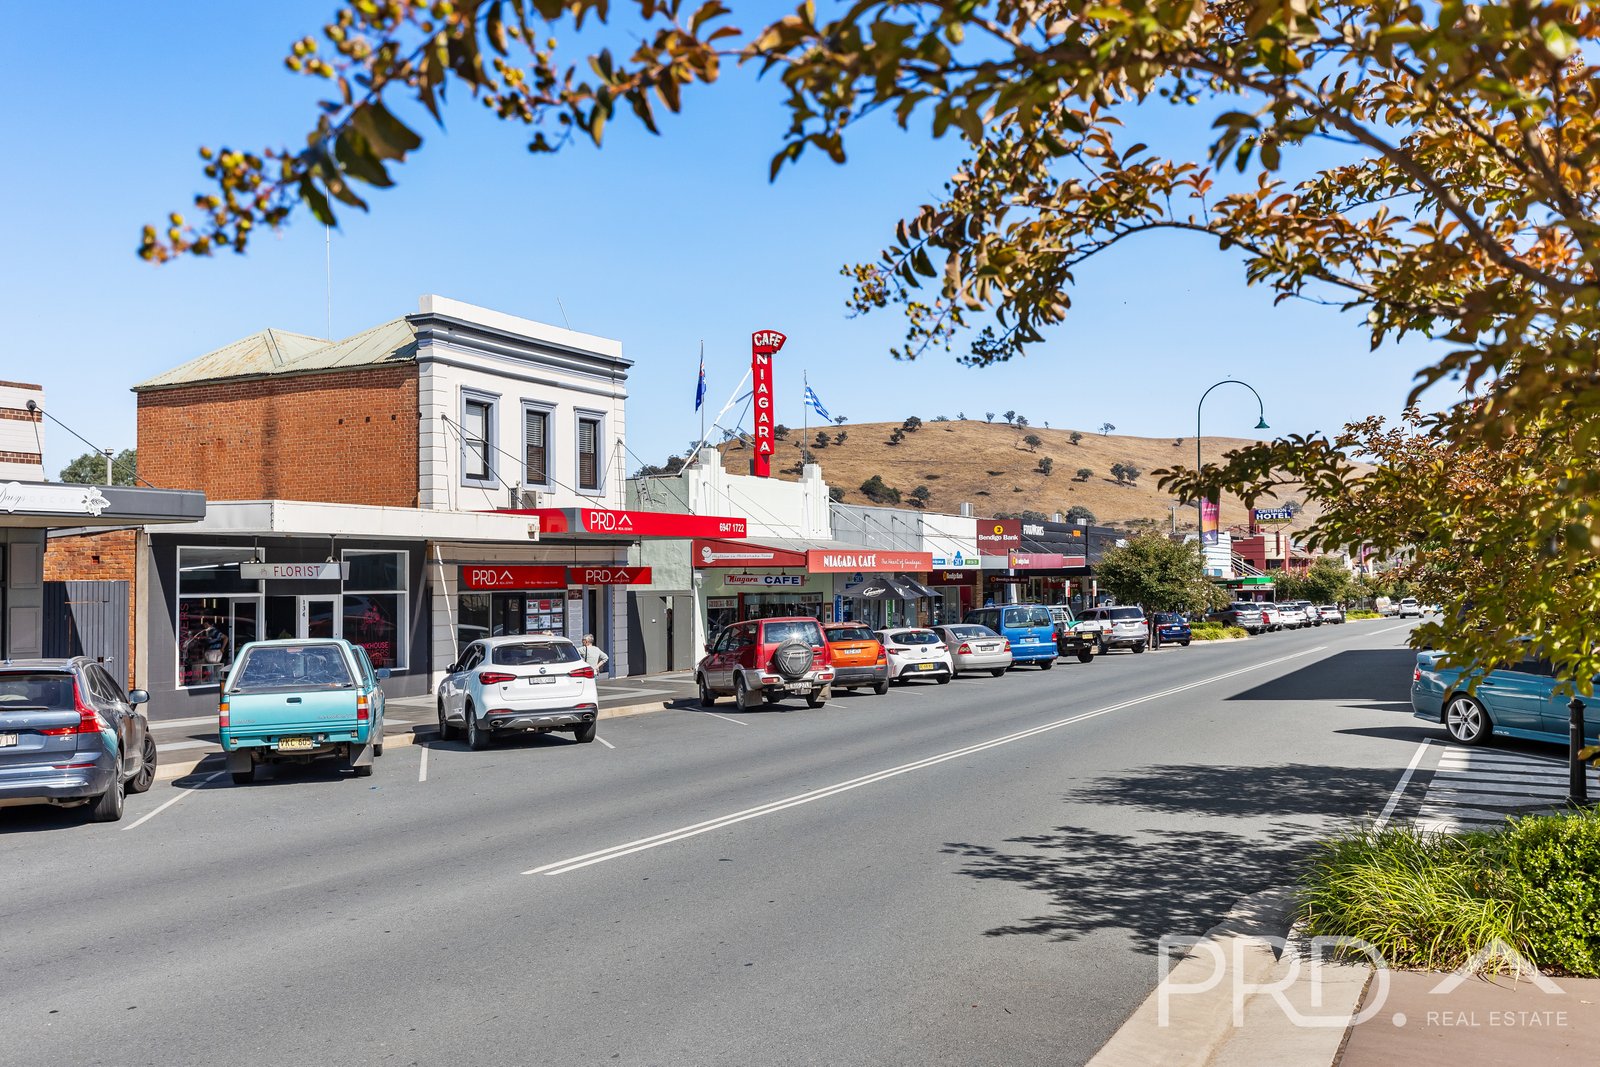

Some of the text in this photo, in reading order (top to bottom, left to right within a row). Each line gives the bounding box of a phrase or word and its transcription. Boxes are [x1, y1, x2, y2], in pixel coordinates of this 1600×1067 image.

[754, 332, 782, 347] CAFE
[757, 353, 770, 452] NIAGARA
[719, 522, 745, 533] 6947 1722
[823, 553, 877, 567] NIAGARA CAFÉ
[273, 565, 321, 577] FLORIST
[727, 575, 800, 584] Niagara CAFE
[280, 738, 295, 747] VKC
